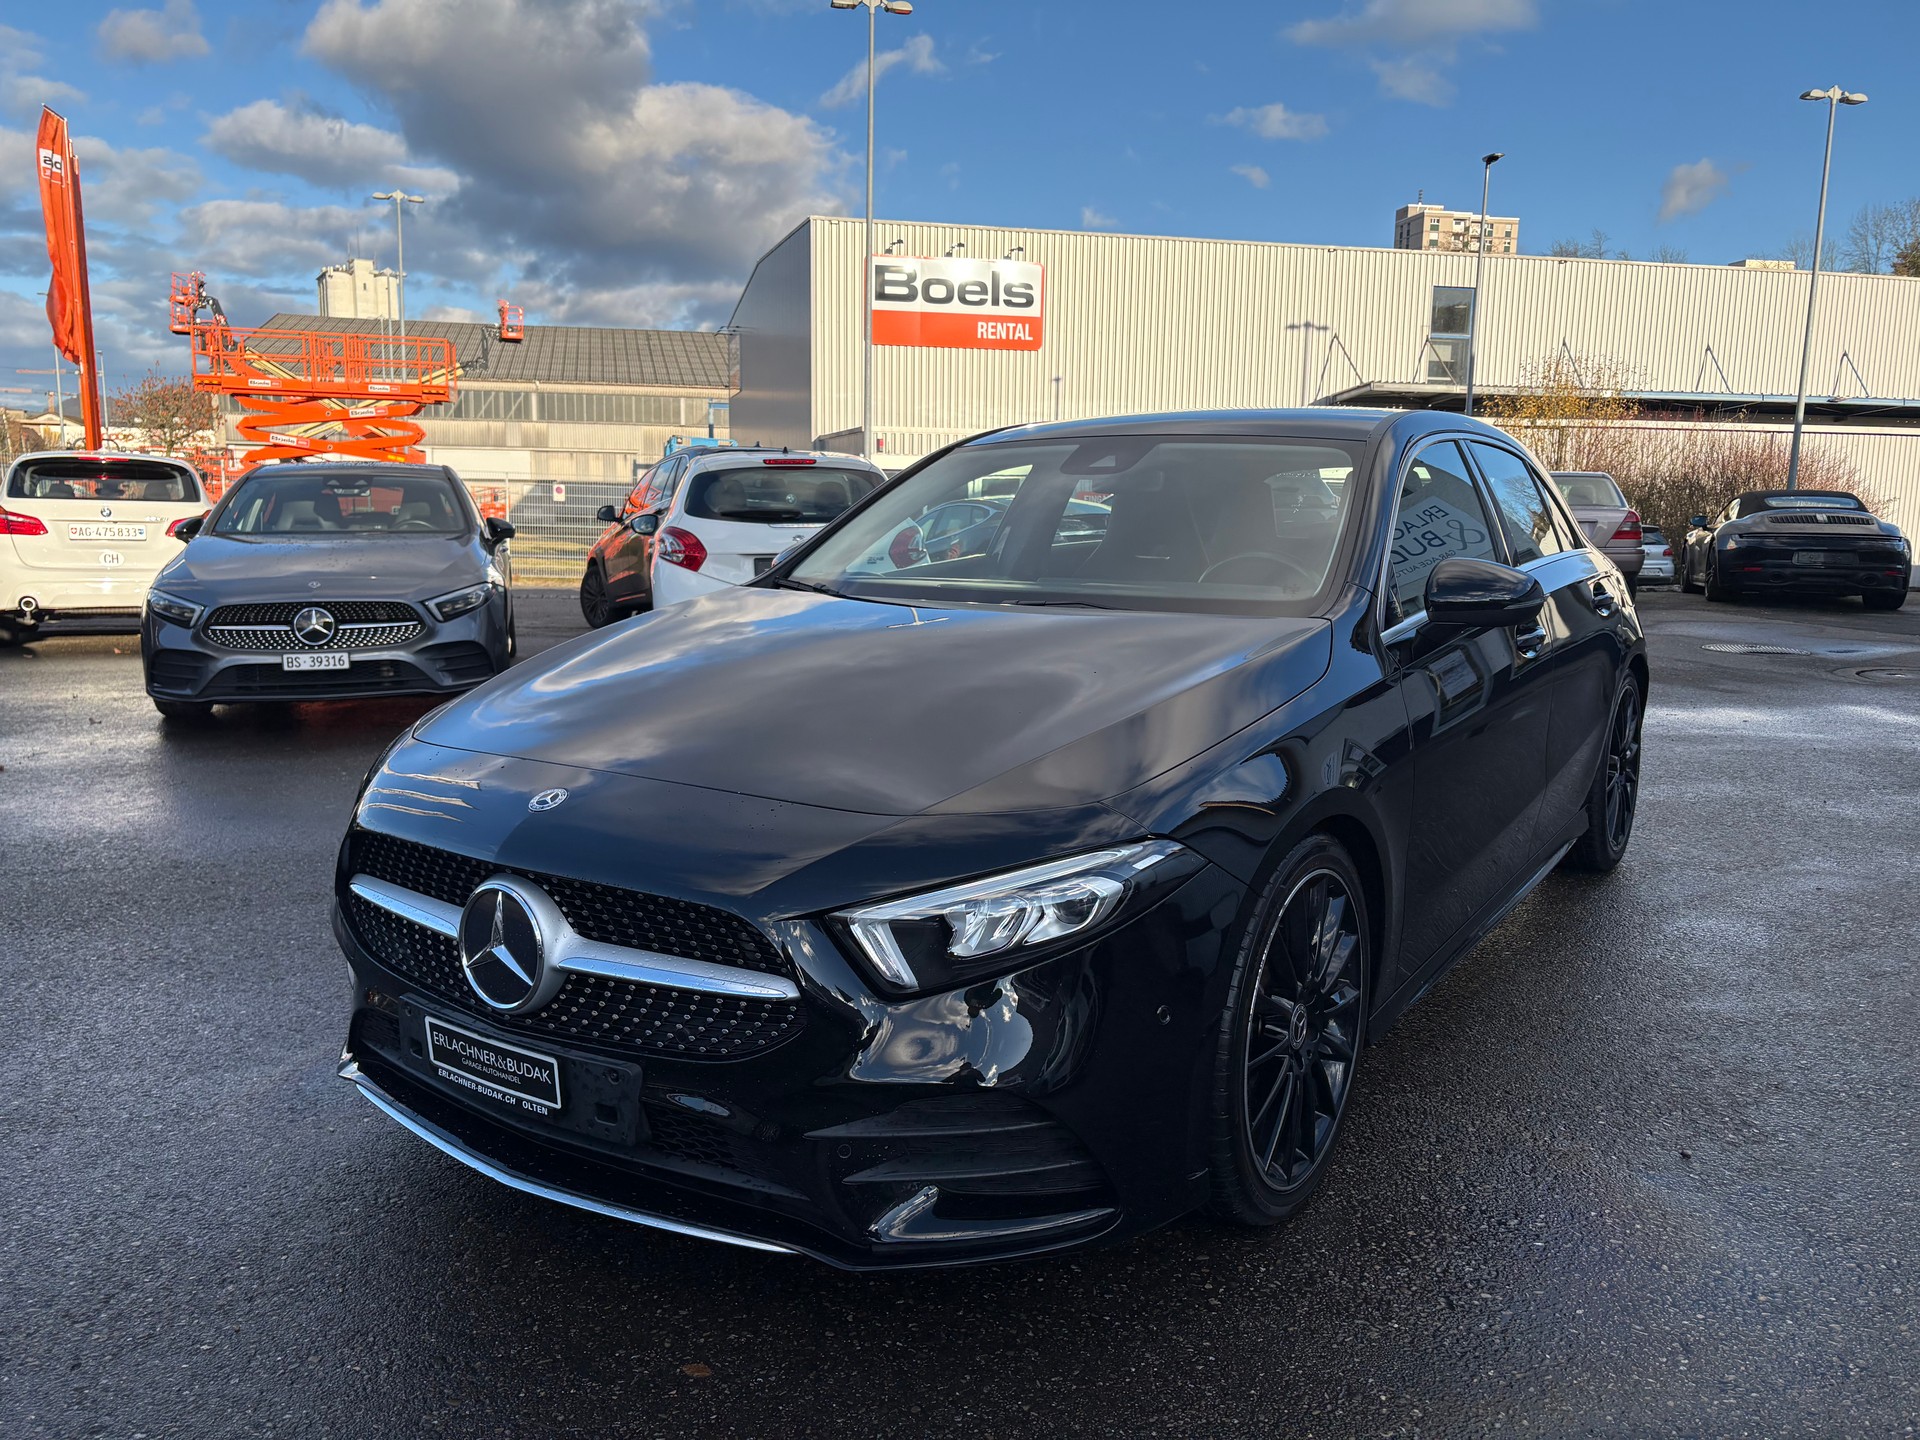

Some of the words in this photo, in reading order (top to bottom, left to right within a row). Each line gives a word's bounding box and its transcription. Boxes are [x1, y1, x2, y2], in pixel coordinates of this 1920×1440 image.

[874, 264, 1035, 309] Boels
[977, 321, 1034, 341] RENTAL
[103, 553, 120, 564] CH
[433, 1031, 552, 1085] ERLACHNER&BUDAK
[461, 1057, 483, 1072] GARAGE
[482, 1065, 522, 1085] AUTOHANDEL
[438, 1068, 516, 1106] ERLACHNER-BUDAK.CH
[522, 1100, 549, 1116] OLTEN
